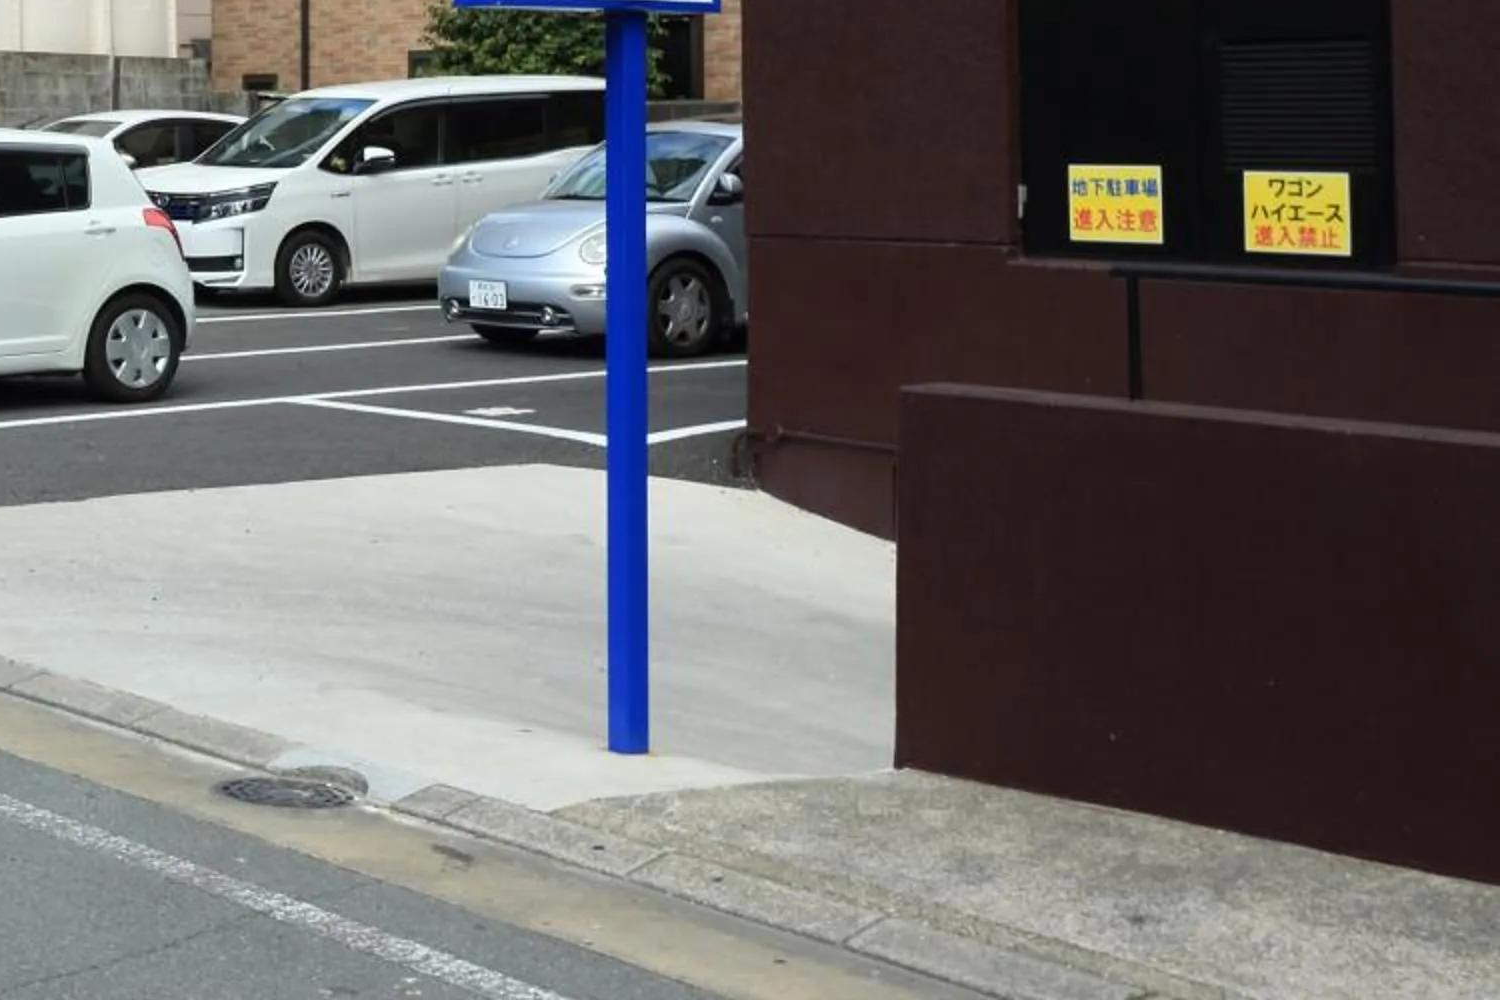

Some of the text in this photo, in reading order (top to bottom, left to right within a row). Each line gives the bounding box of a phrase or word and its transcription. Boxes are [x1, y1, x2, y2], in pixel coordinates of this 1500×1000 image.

[1071, 177, 1158, 197] 地下駐車場
[1268, 178, 1323, 199] ワゴン
[1073, 209, 1157, 233] 進入注意
[1251, 204, 1344, 223] ハイエース
[1254, 225, 1341, 249] 進入禁止
